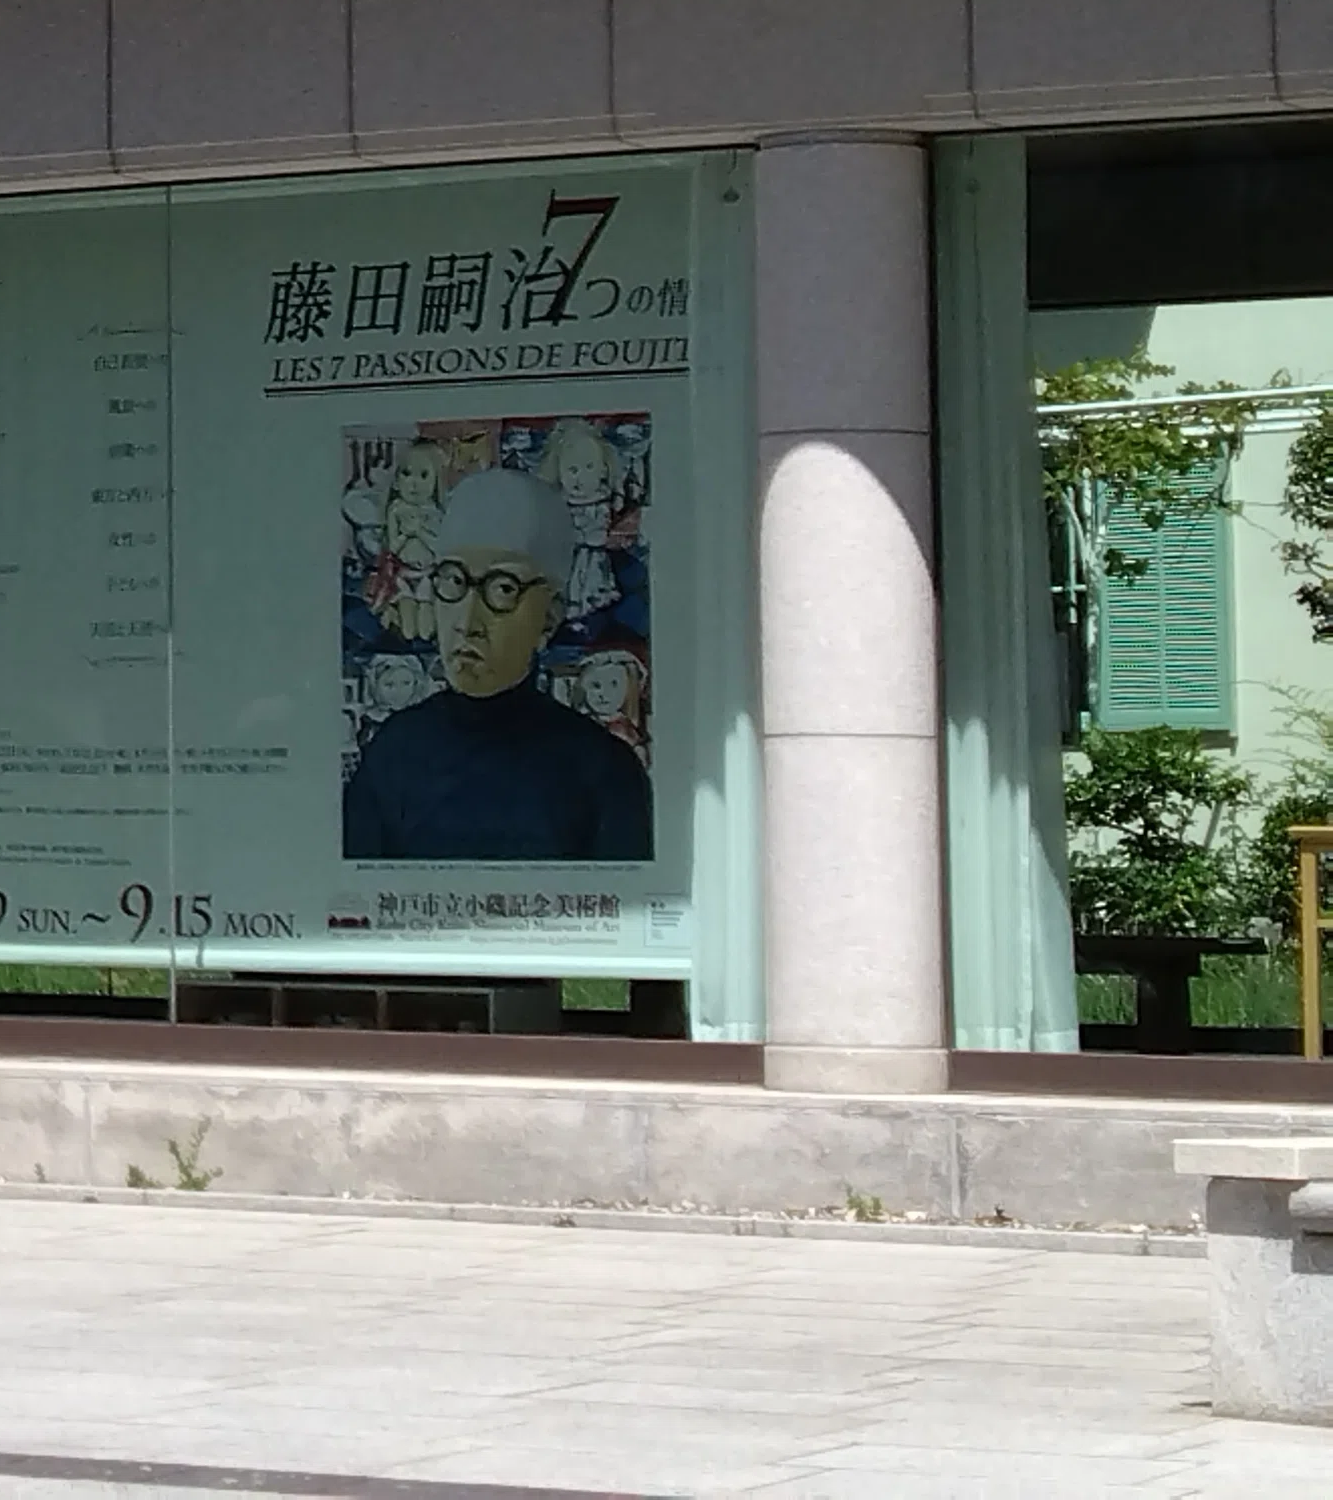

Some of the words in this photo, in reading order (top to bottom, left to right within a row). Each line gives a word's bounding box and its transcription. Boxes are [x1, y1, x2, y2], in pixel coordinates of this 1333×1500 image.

[271, 354, 323, 383] LES
[330, 356, 346, 381] 7
[353, 345, 509, 379] PASSIONS
[517, 342, 565, 371] DE
[17, 908, 78, 934] SUN.
[119, 882, 213, 944] 9.15
[222, 911, 302, 940] MON.
